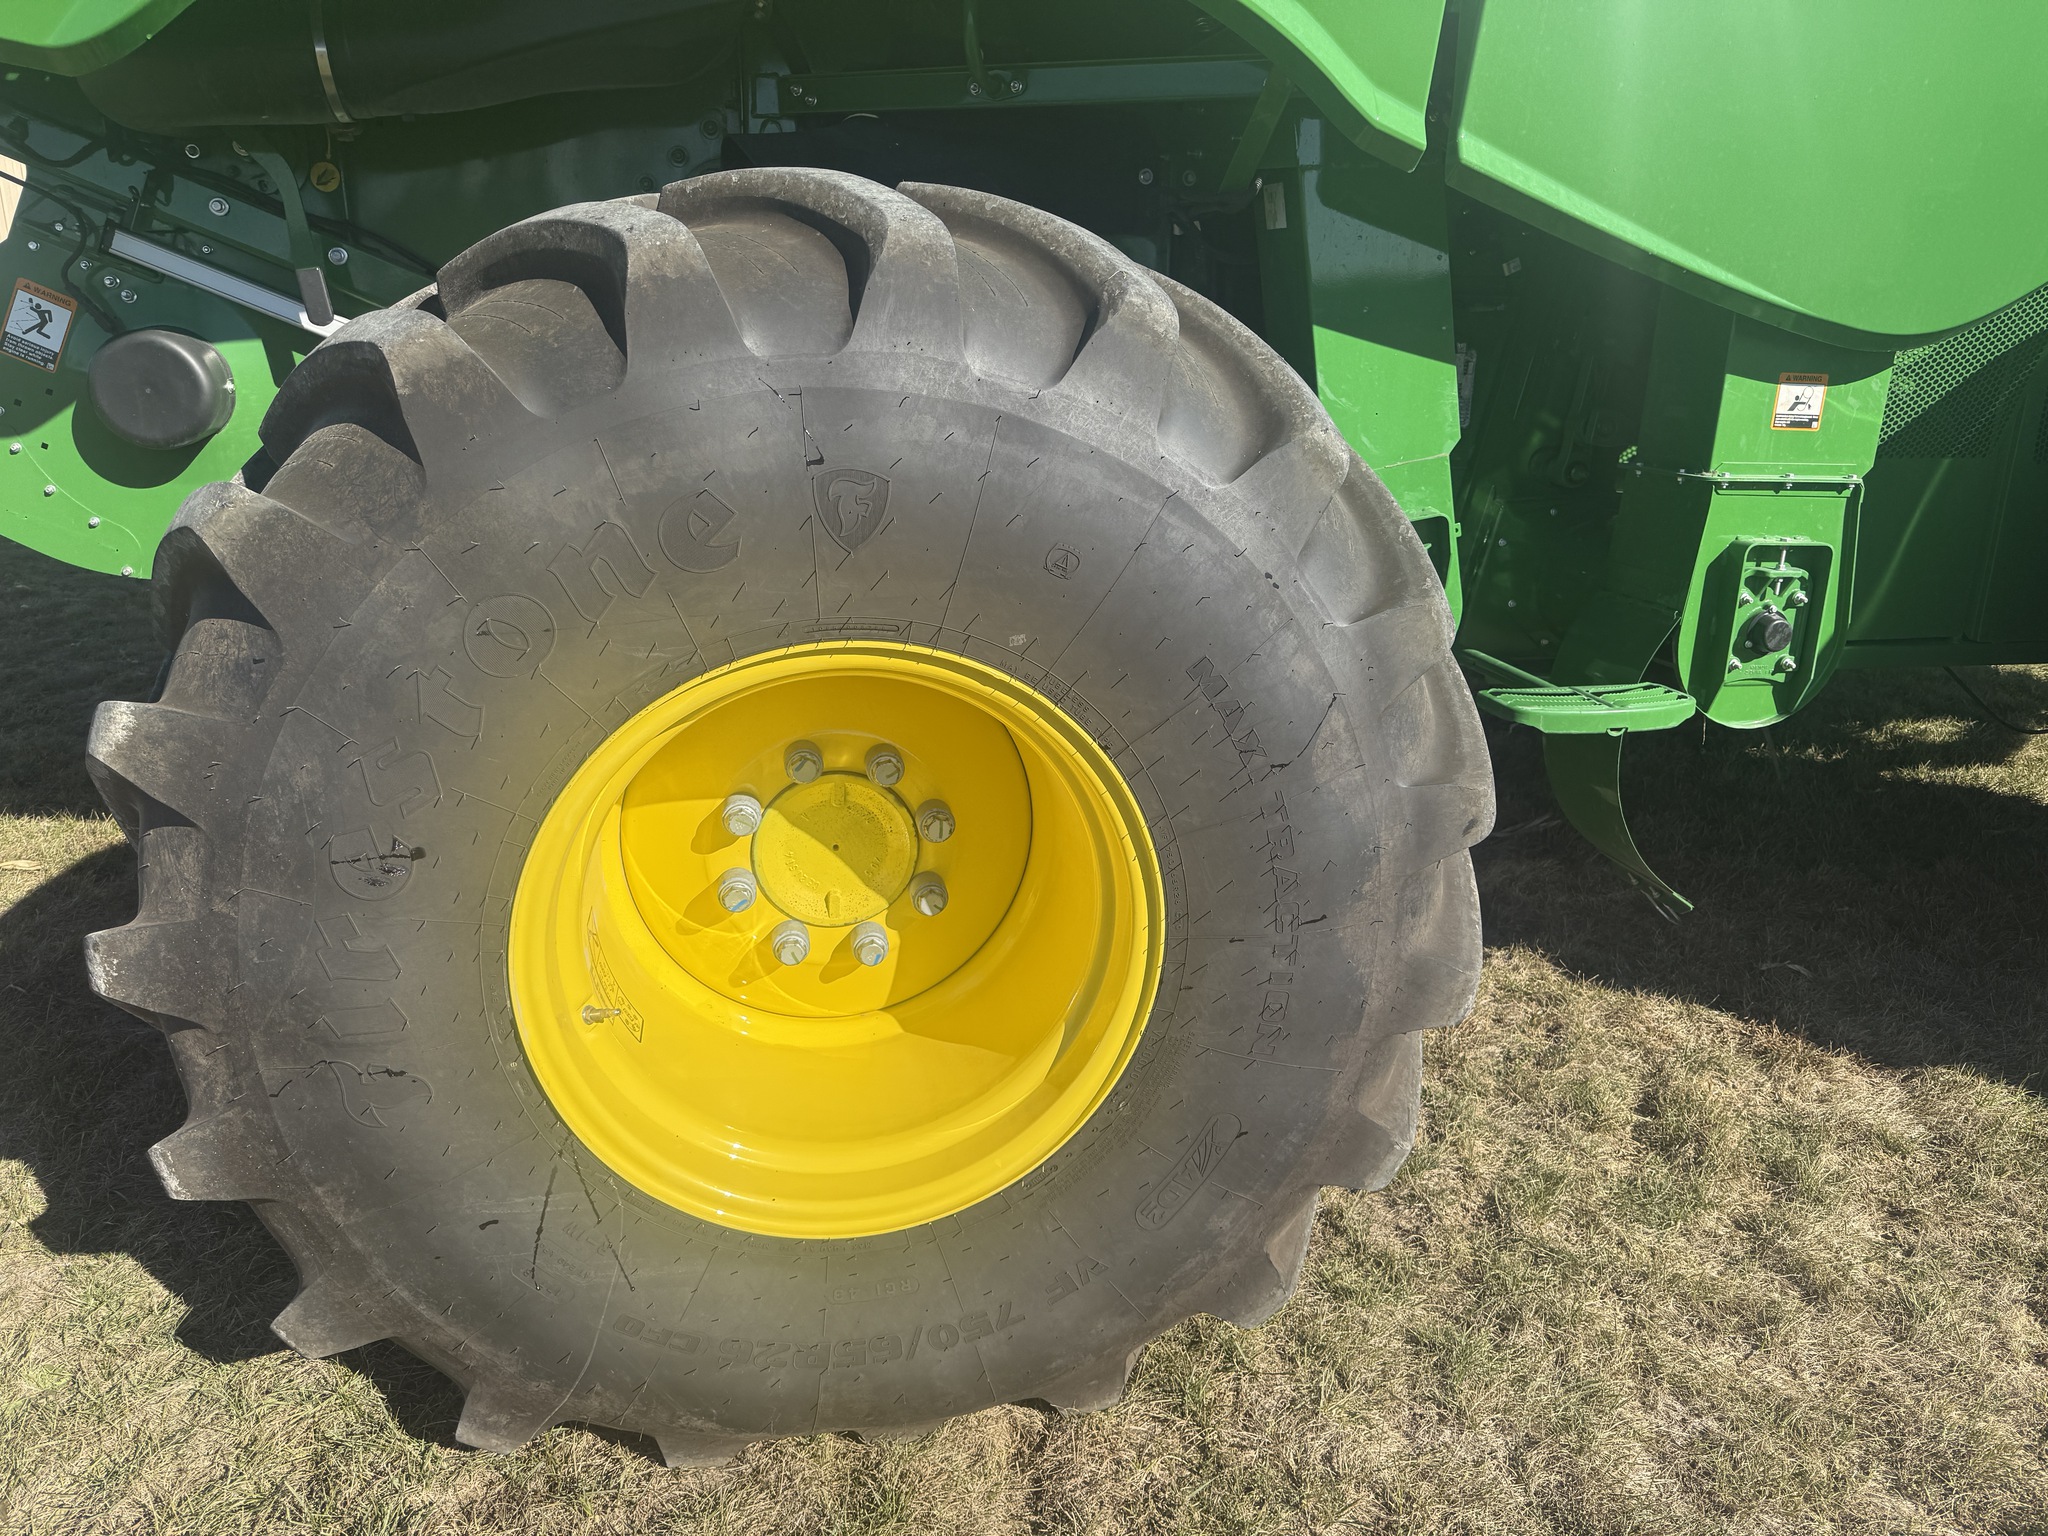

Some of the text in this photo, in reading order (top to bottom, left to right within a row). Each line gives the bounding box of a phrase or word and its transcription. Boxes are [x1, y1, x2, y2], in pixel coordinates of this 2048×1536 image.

[33, 286, 72, 307] WARNING
[1792, 374, 1823, 383] WARNING
[1044, 673, 1090, 714] TUBELESS
[1251, 790, 1300, 1056] TRACTION
[610, 1253, 1110, 1371] VF 750/65R26 CFO
